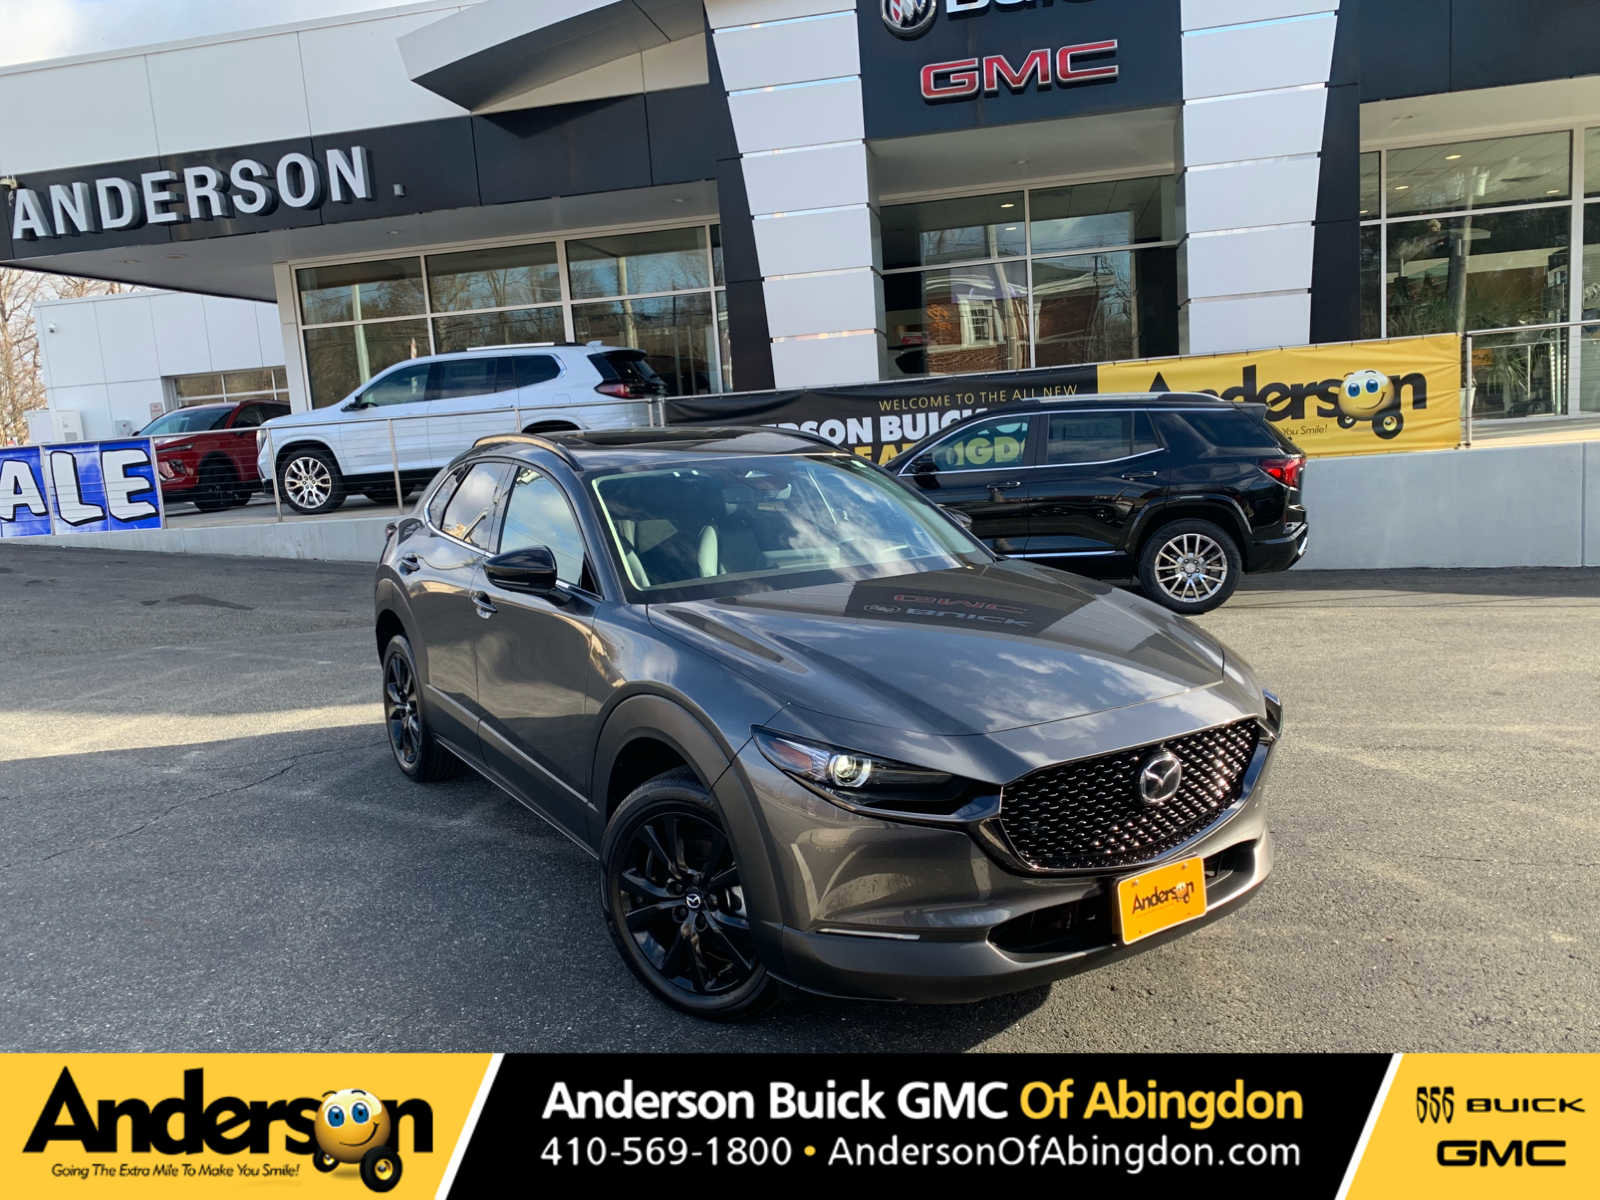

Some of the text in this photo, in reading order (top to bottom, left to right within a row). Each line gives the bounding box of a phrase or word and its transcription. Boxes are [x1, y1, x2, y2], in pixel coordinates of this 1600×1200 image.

[920, 39, 1119, 99] GMC
[12, 146, 371, 240] ANDERSON
[879, 396, 950, 411] WELCOME
[955, 393, 975, 405] TO
[980, 391, 1007, 404] THE
[1043, 384, 1078, 400] NEW
